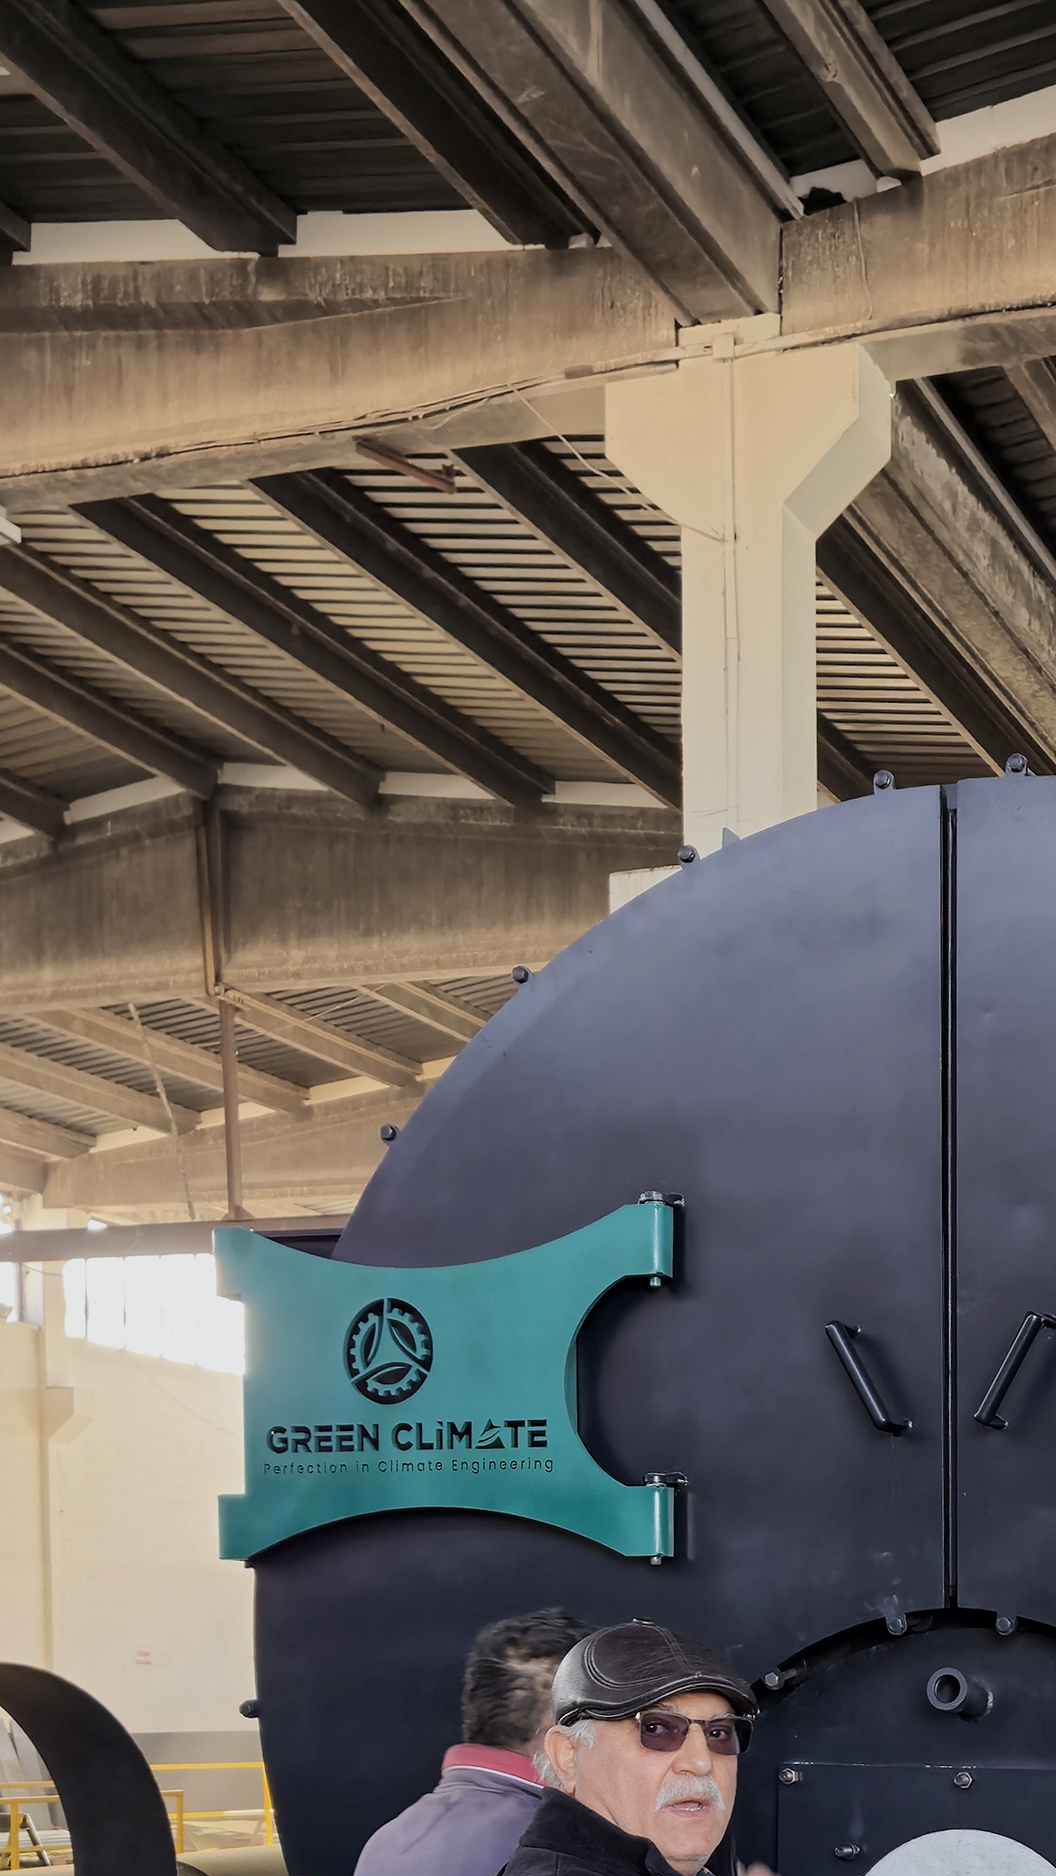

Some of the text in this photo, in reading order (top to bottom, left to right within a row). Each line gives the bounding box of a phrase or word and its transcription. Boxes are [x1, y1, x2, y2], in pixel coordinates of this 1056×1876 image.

[266, 1422, 380, 1454] GREEN
[263, 1456, 554, 1475] Perfection in Climate Engineering
